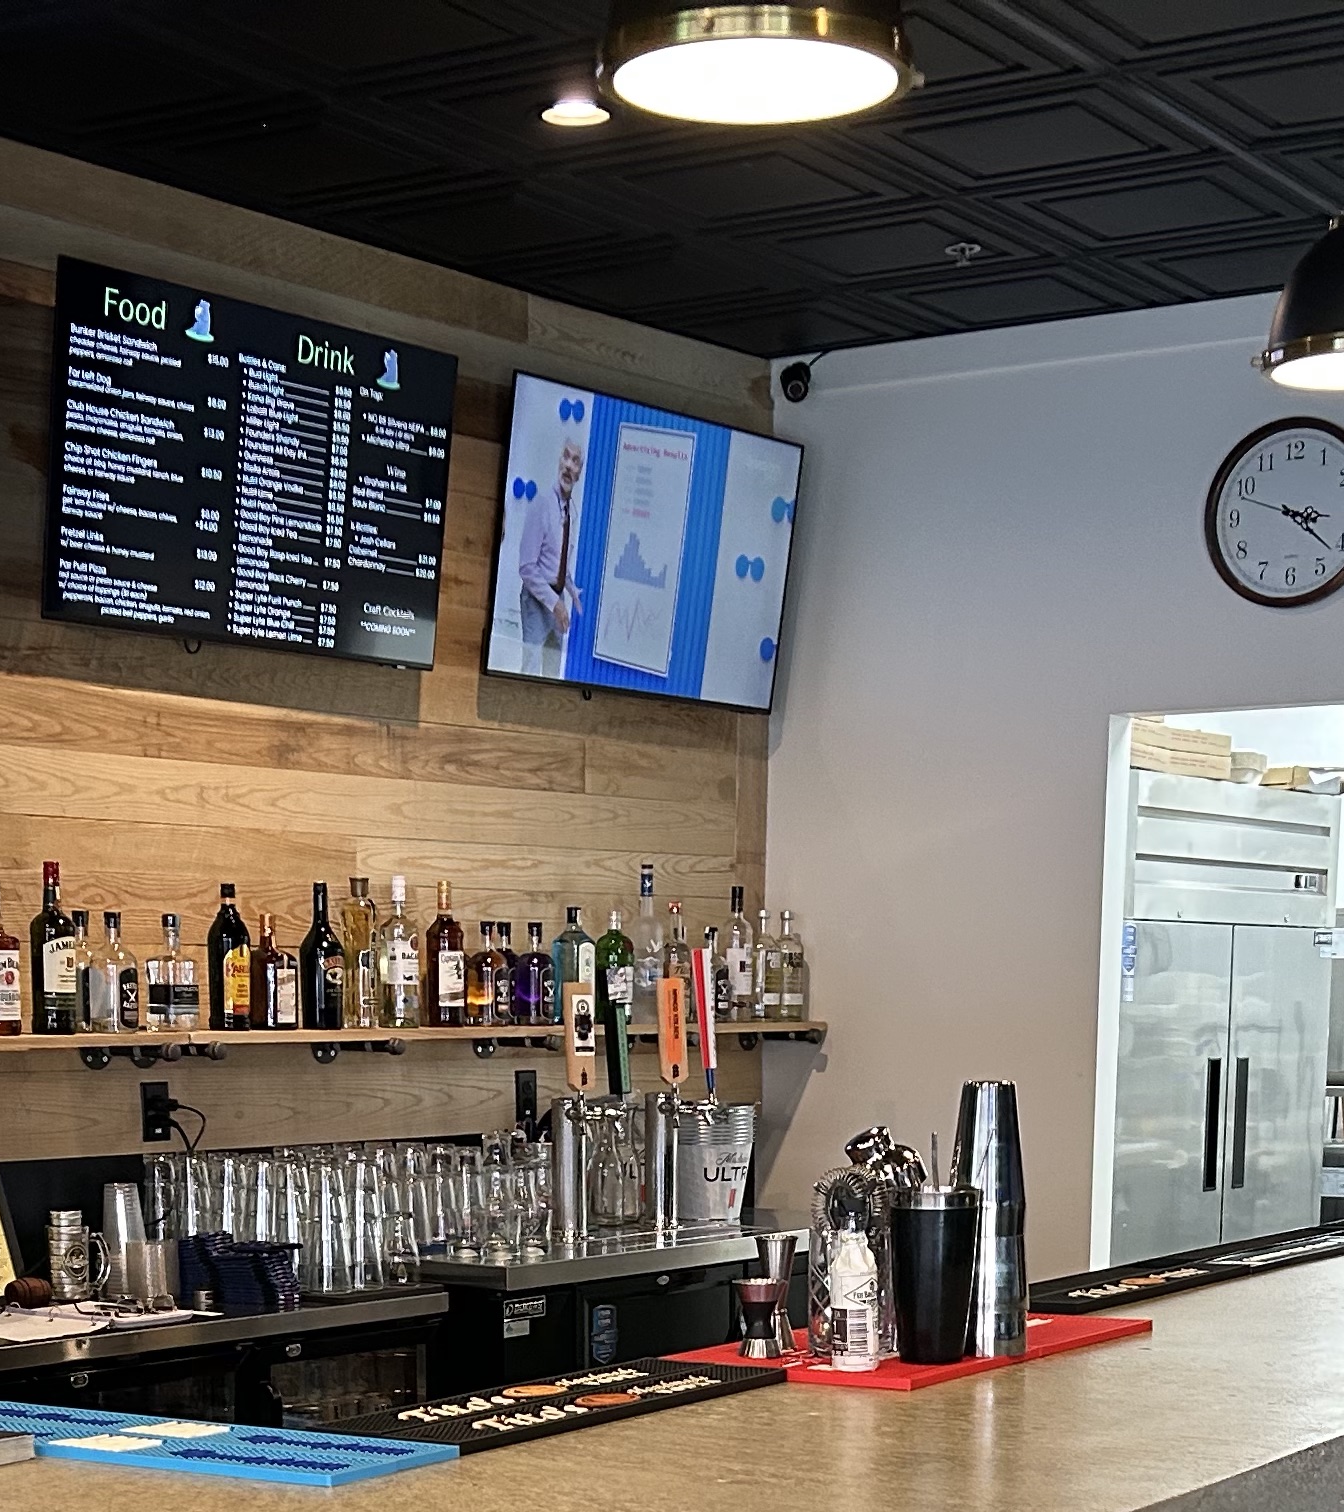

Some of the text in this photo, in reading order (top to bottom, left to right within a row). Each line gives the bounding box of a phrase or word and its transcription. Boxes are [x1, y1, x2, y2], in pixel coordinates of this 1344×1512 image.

[104, 286, 167, 331] Food
[297, 334, 355, 376] Drink
[1286, 440, 1305, 462] 12
[1319, 447, 1327, 466] 1
[1257, 452, 1274, 472] 11
[1237, 475, 1256, 497] 10
[1229, 508, 1240, 529] 9
[1236, 540, 1248, 560] 8
[1258, 561, 1269, 581] 7
[1285, 566, 1296, 587] 6
[1314, 557, 1326, 576] 5
[49, 940, 76, 954] JAME
[471, 1404, 589, 1432] Tito's
